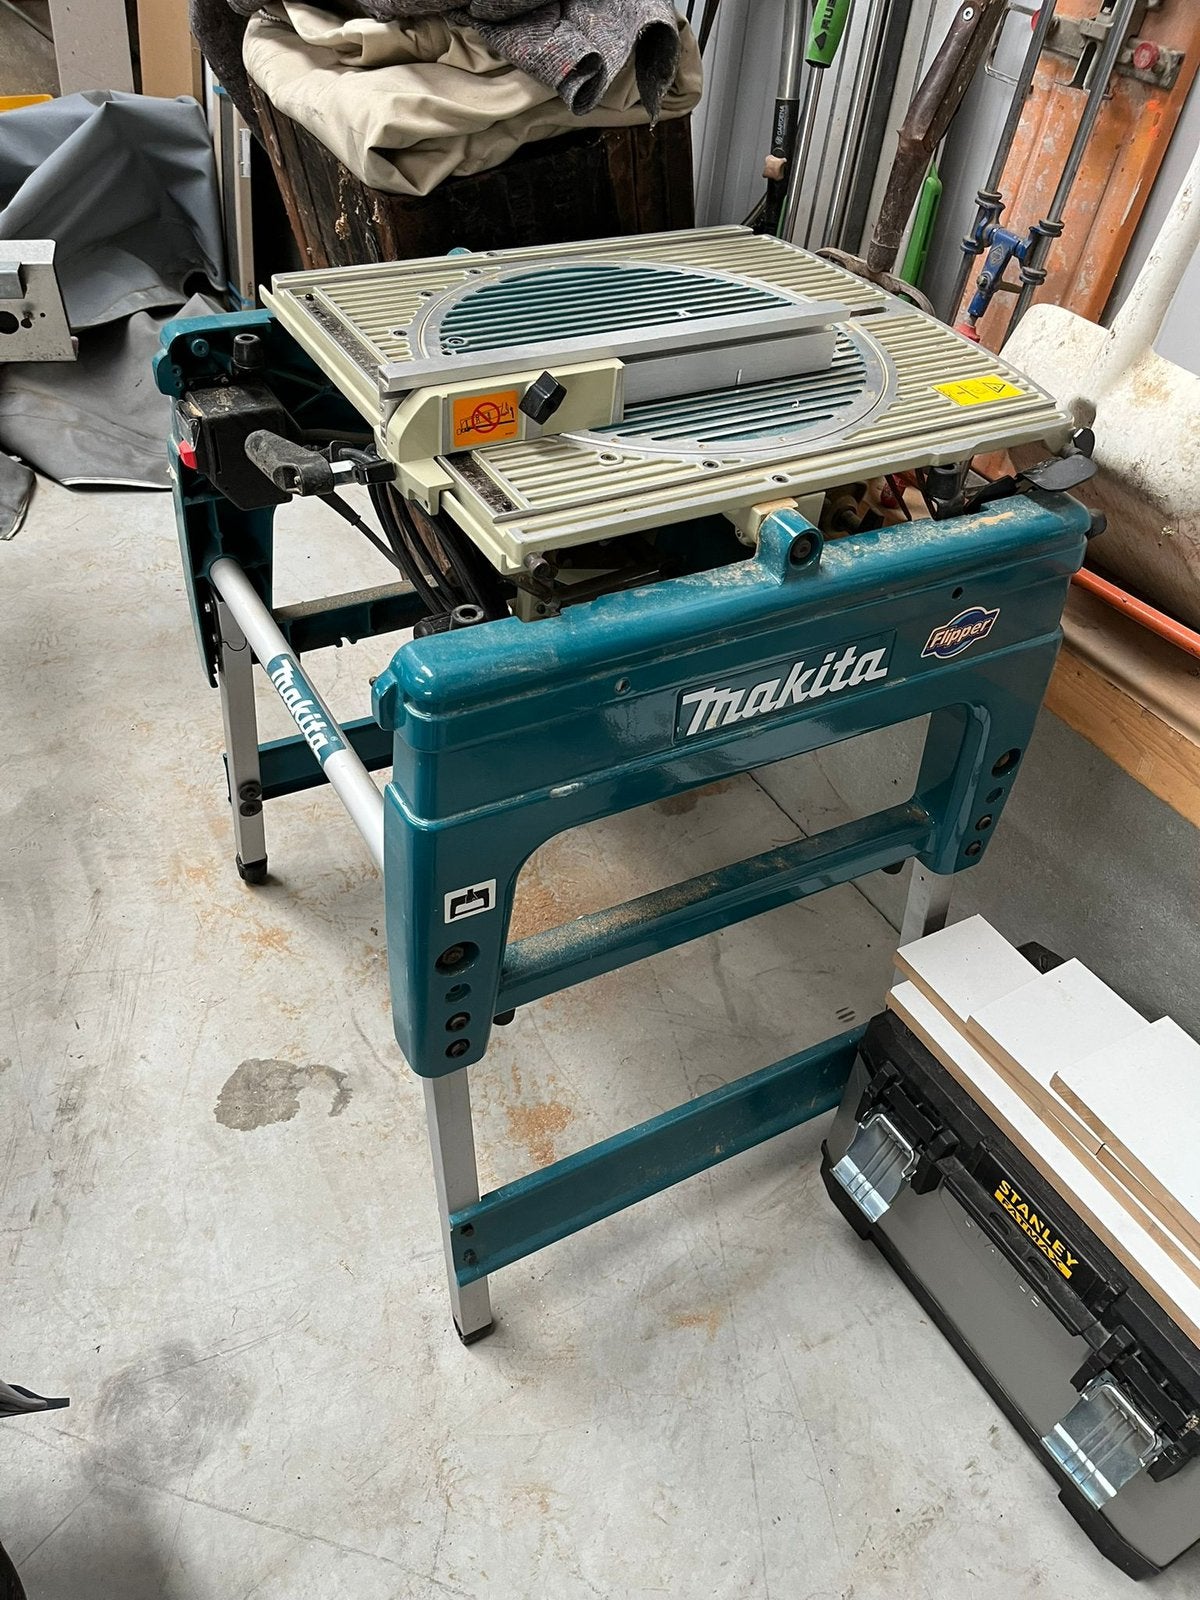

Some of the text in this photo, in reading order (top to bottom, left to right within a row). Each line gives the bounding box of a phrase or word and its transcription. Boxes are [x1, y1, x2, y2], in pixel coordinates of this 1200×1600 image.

[929, 618, 993, 648] Flipper
[999, 1180, 1079, 1267] STANLEY
[1001, 1197, 1064, 1272] FATMAX
